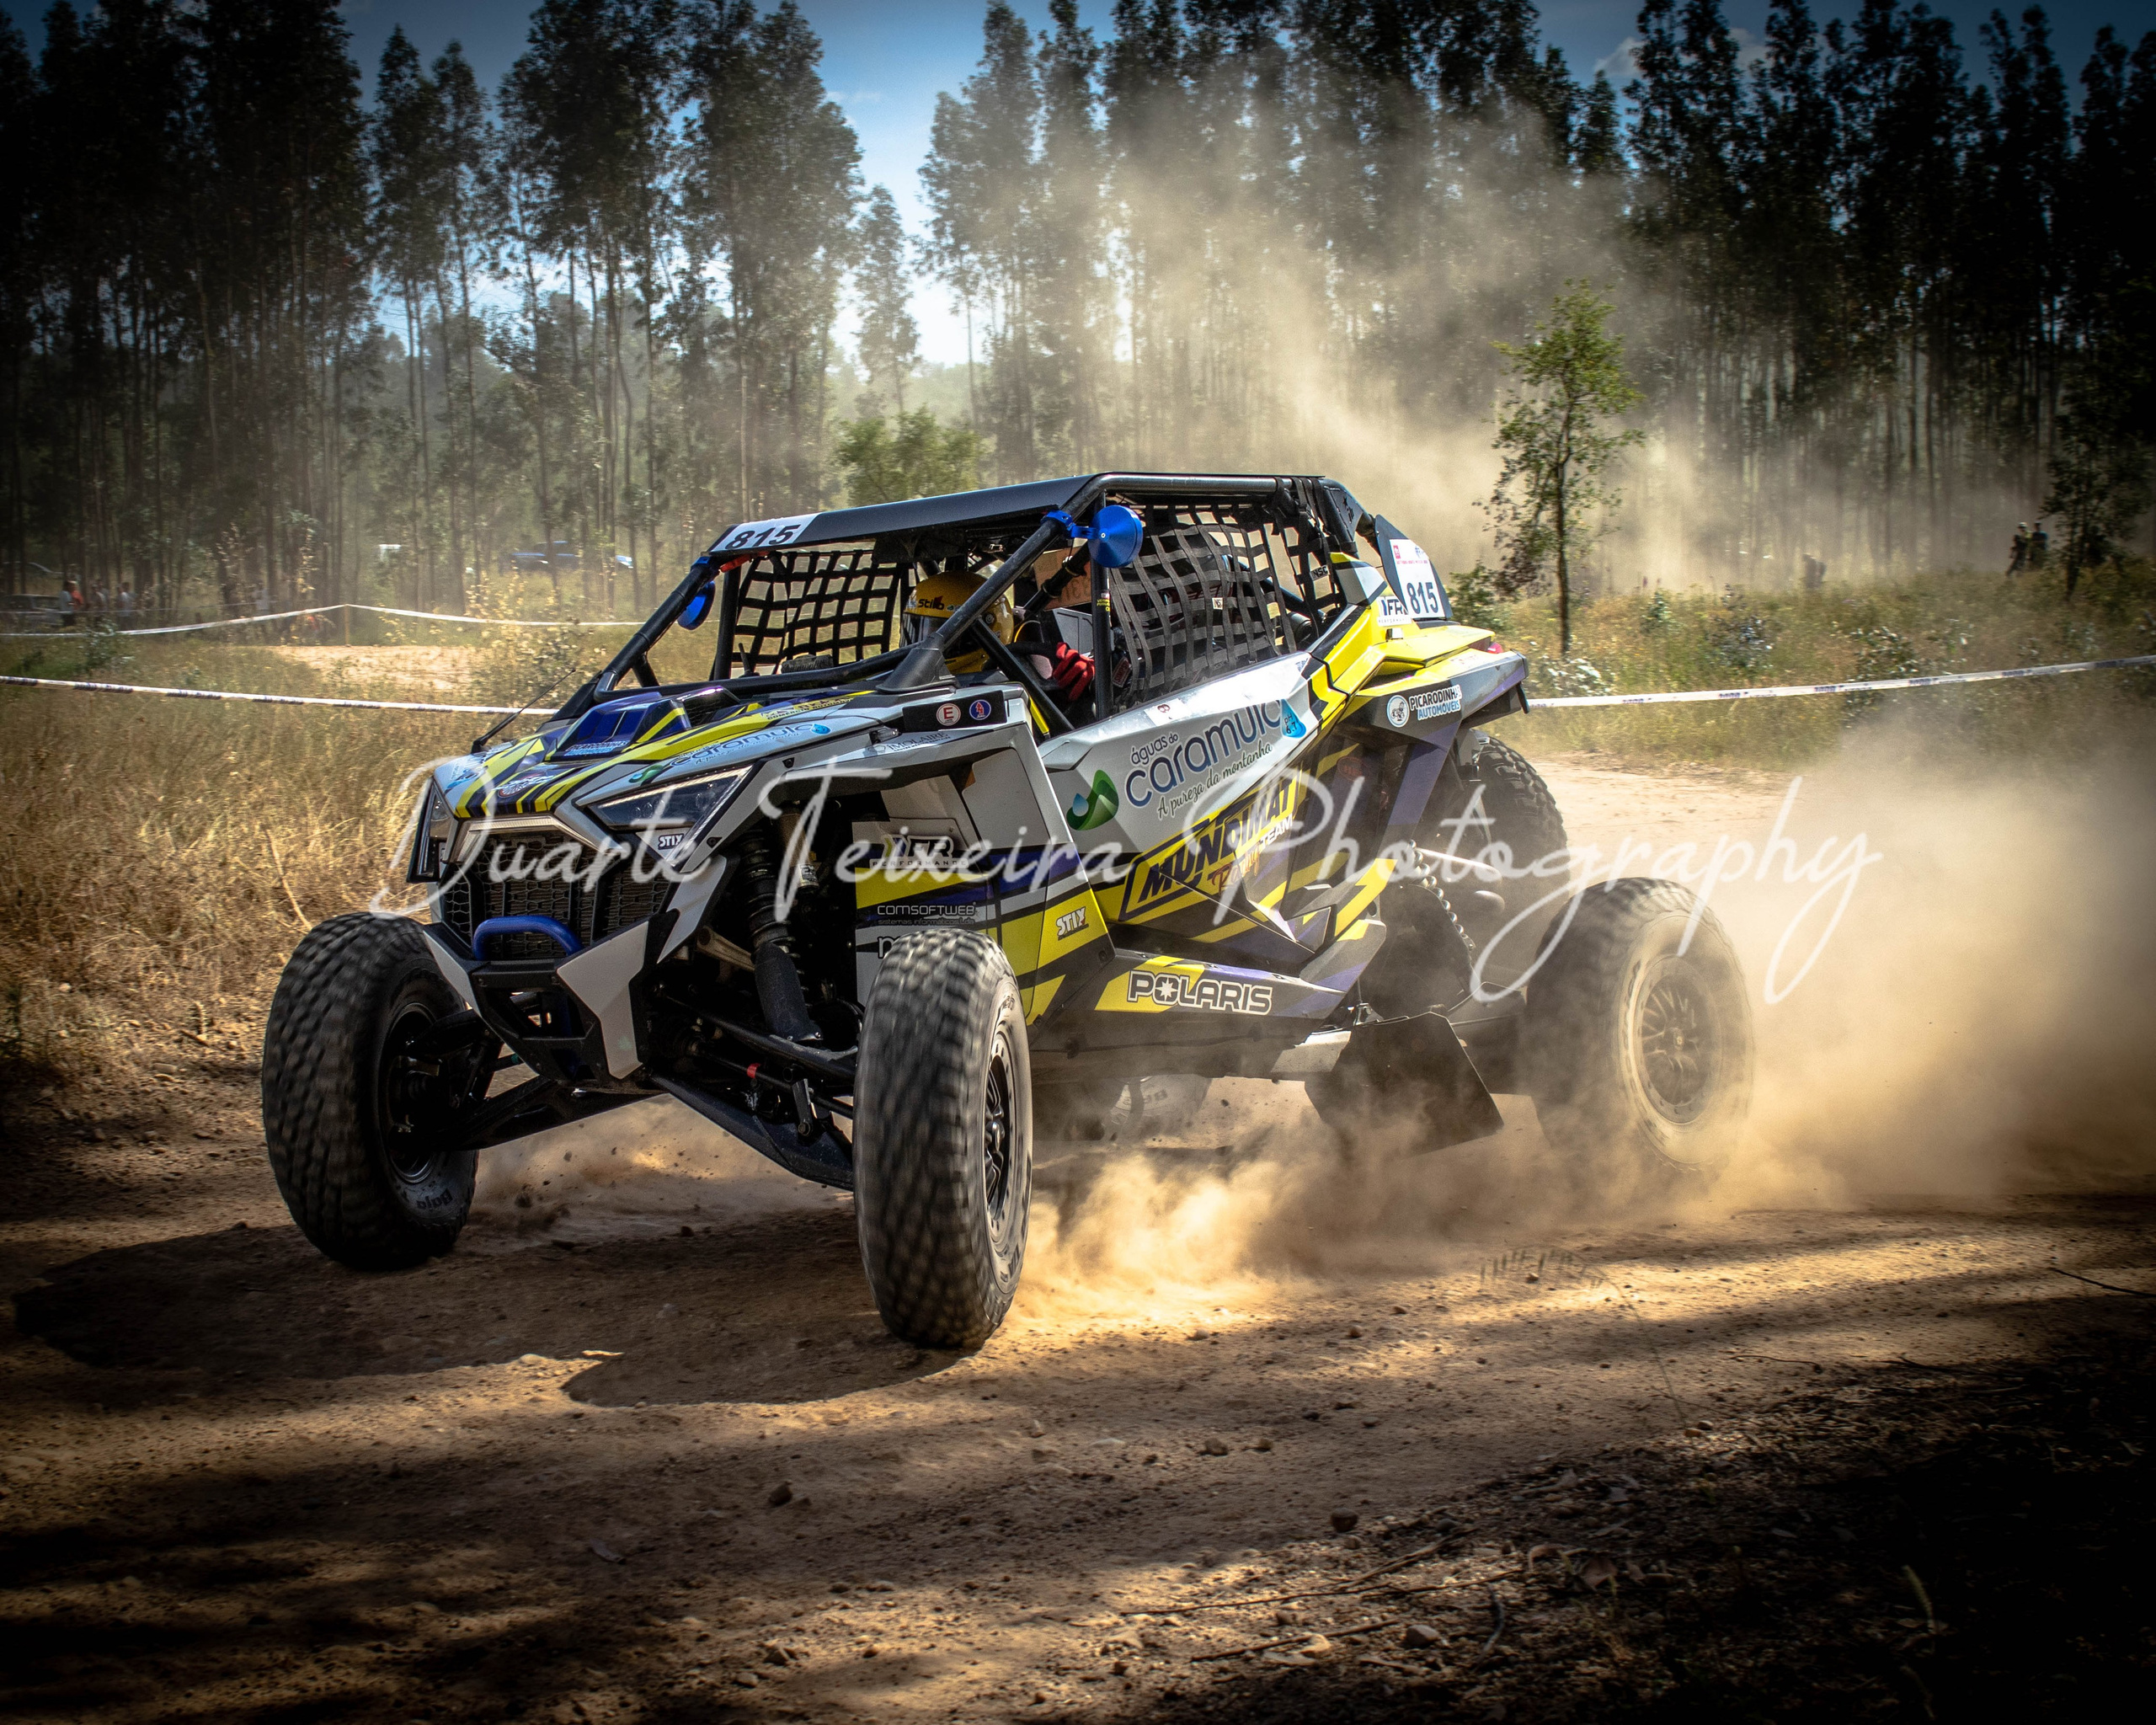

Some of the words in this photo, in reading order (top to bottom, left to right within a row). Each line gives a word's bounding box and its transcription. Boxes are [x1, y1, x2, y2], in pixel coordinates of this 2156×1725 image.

[725, 524, 801, 549] 815
[1406, 581, 1438, 614] 815
[943, 707, 954, 719] E
[1410, 686, 1462, 709] PICARODINH
[1125, 699, 1282, 807] caramulo
[1131, 735, 1169, 766] águas
[1169, 732, 1179, 745] do
[1158, 797, 1169, 819] A
[1171, 782, 1205, 812] pureza
[1206, 766, 1221, 788] da
[1222, 739, 1273, 779] montanha
[658, 833, 683, 848] STIX
[1137, 775, 1298, 904] MUNDIMAT
[1260, 814, 1294, 849] TEAM
[877, 905, 974, 915] COMSOFTWEB
[878, 916, 912, 925] sistemas
[1056, 905, 1086, 937] STIX
[1127, 969, 1273, 1016] POLARIS
